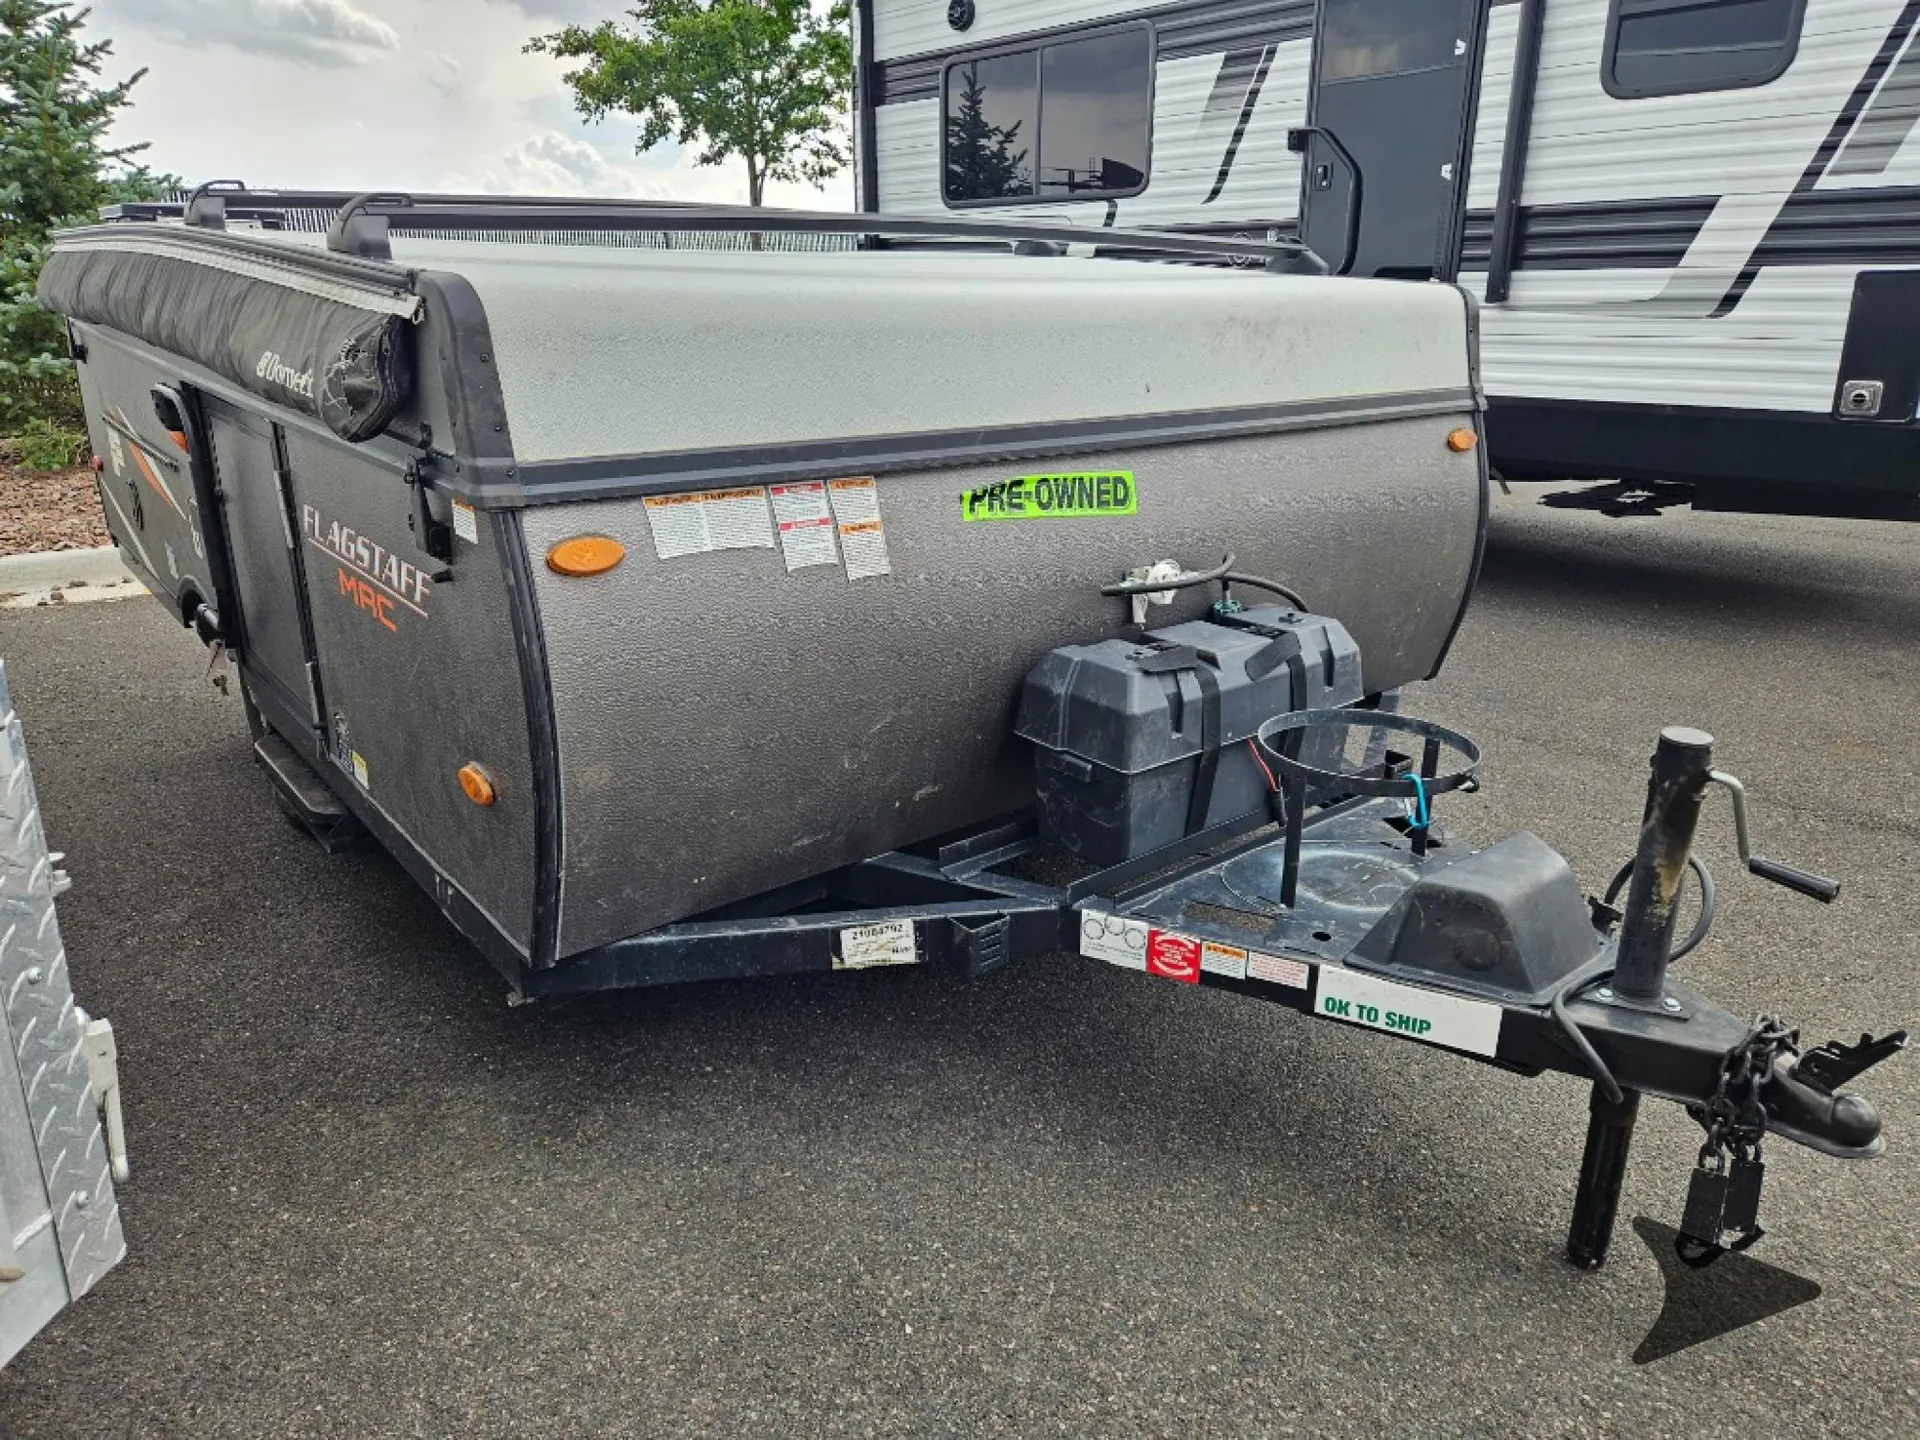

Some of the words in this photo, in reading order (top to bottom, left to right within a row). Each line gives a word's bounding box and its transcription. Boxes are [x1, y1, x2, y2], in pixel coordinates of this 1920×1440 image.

[968, 476, 1130, 513] PRE-OWNED
[303, 504, 431, 603] FLAGSTAFF
[1324, 997, 1351, 1017] OK
[1356, 1004, 1379, 1023] TO
[1385, 1012, 1432, 1034] SHIP
